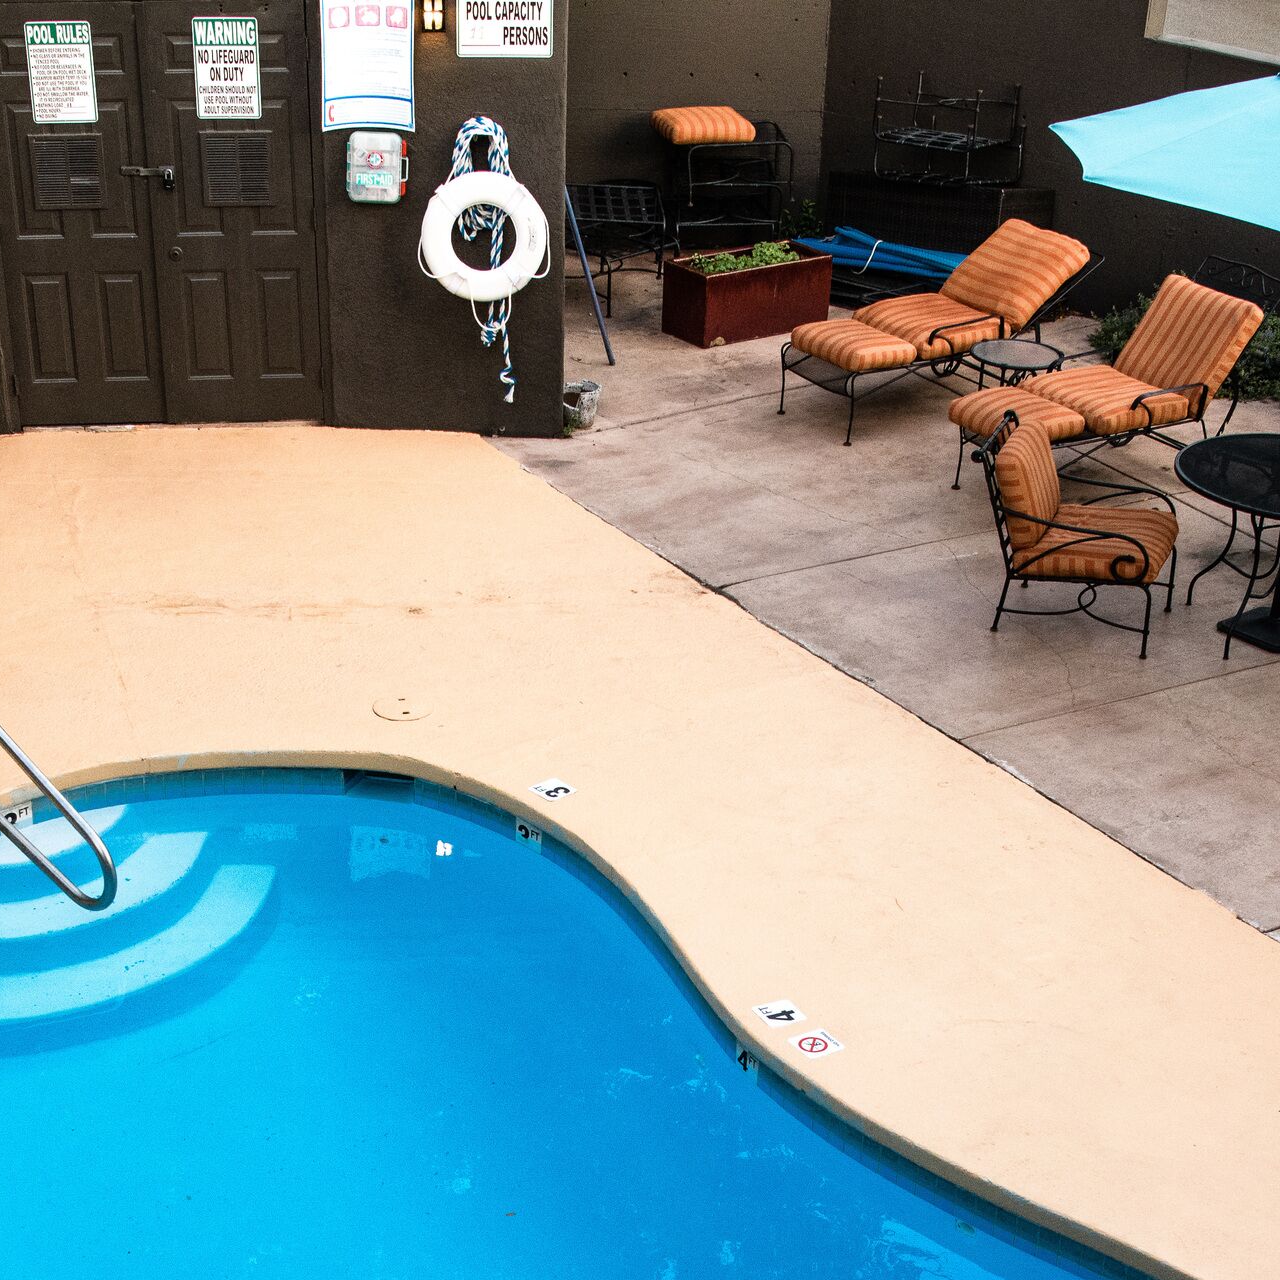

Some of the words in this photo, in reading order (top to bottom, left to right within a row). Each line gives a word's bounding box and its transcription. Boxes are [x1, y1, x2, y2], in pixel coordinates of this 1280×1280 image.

[466, 1, 492, 20] POOL
[495, 1, 543, 20] CAPACITY
[26, 24, 55, 44] POOL
[56, 24, 89, 44] RULES
[194, 21, 256, 45] WARNING
[503, 26, 548, 46] PERSONS
[197, 49, 209, 64] NO
[211, 49, 255, 64] LIFEGUARD
[210, 67, 221, 81] ON
[223, 67, 244, 81] DUTY
[199, 85, 224, 94] CHILDREN
[225, 85, 245, 94] SHOULD
[246, 85, 256, 94] NOT
[204, 95, 214, 104] USE
[215, 95, 228, 104] POOL
[229, 95, 252, 104] WITHOUT
[204, 106, 220, 114] ADULT
[221, 106, 254, 114] SUPERVISION
[545, 786, 570, 798] 3
[18, 806, 29, 818] FT
[530, 829, 540, 841] FT
[757, 1006, 773, 1015] FT
[766, 1009, 796, 1021] 4
[737, 1049, 749, 1073] 4
[748, 1055, 757, 1069] FT
